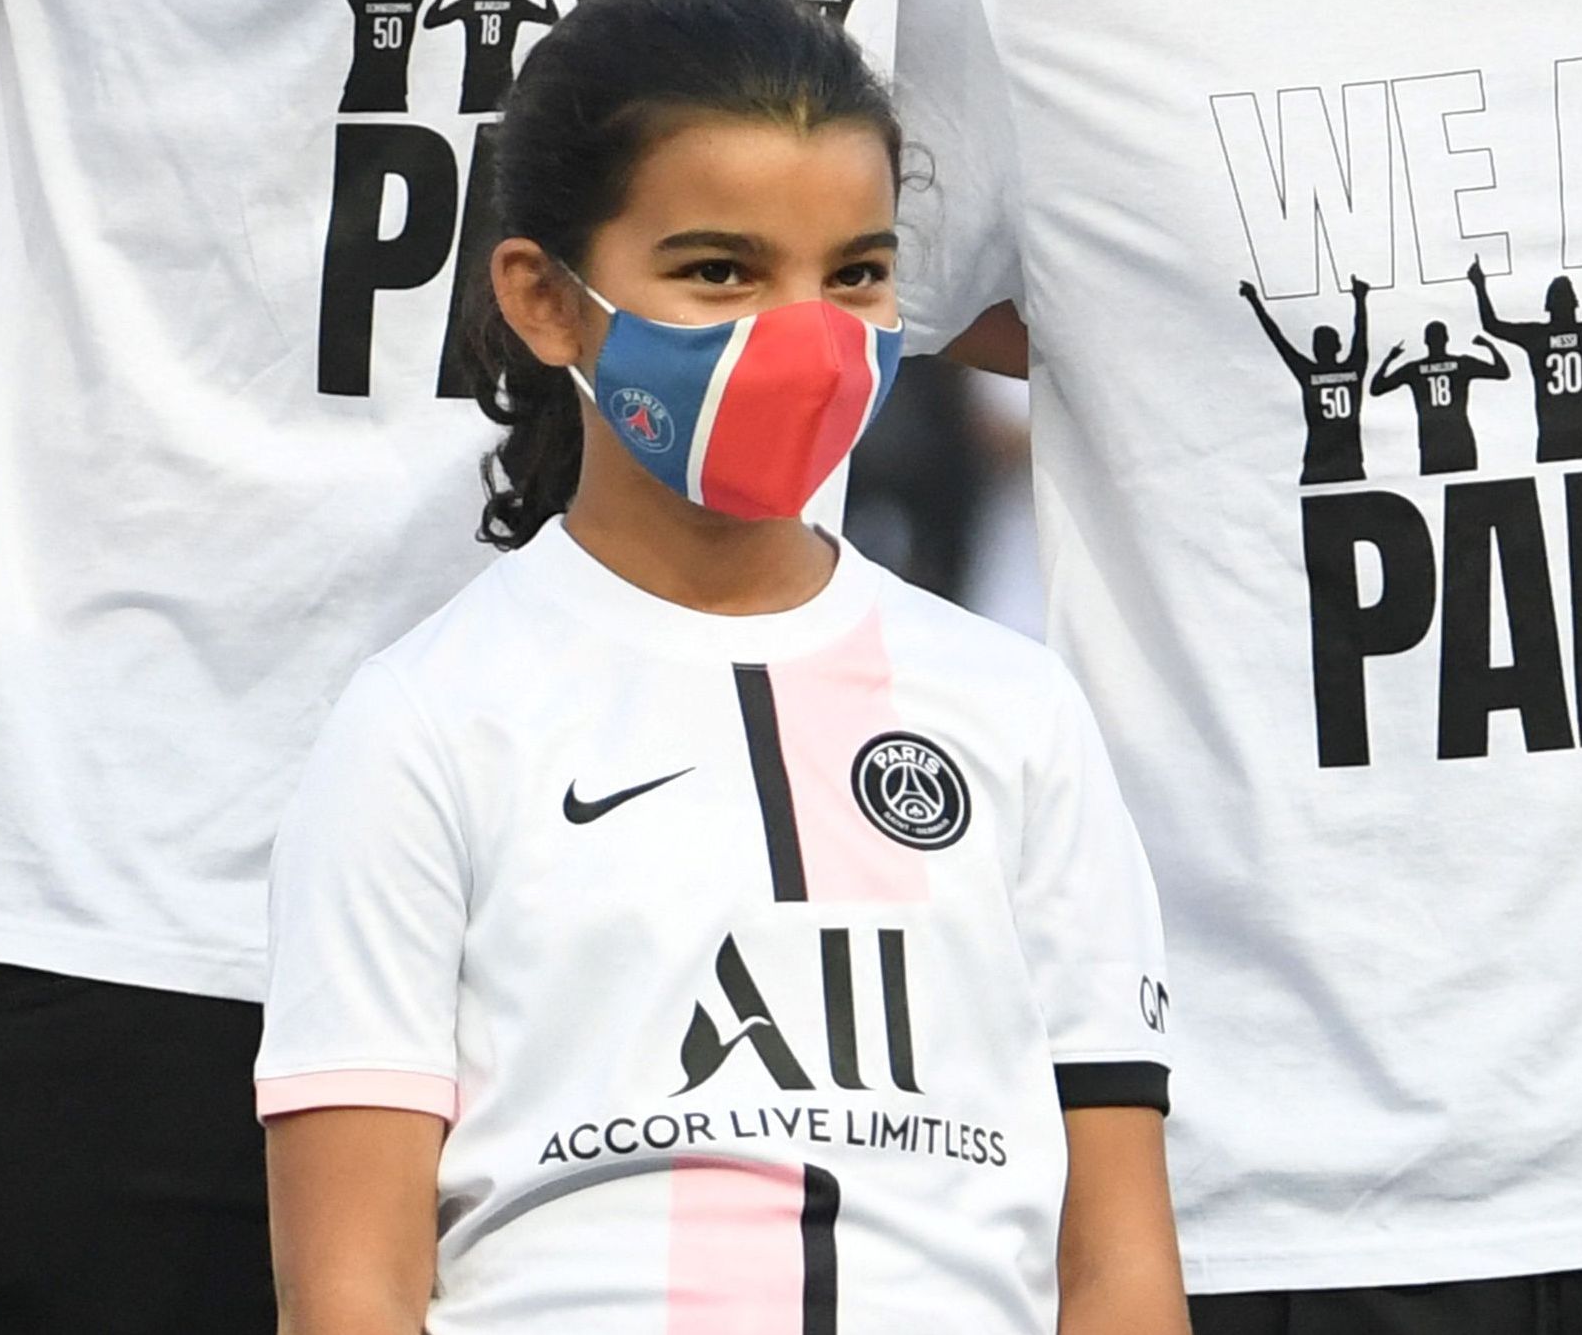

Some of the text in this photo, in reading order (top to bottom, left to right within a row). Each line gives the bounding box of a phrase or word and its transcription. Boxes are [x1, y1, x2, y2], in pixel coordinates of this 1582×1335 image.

[373, 16, 403, 49] 50
[480, 13, 502, 45] 18
[1209, 70, 1512, 300] WE
[1546, 351, 1582, 395] 30
[622, 391, 665, 420] PARIS
[1320, 386, 1352, 419] 50
[1427, 374, 1452, 407] 18
[873, 746, 940, 775] PARIS
[538, 1107, 1007, 1166] ACCOR LIVE LIMITLESS
